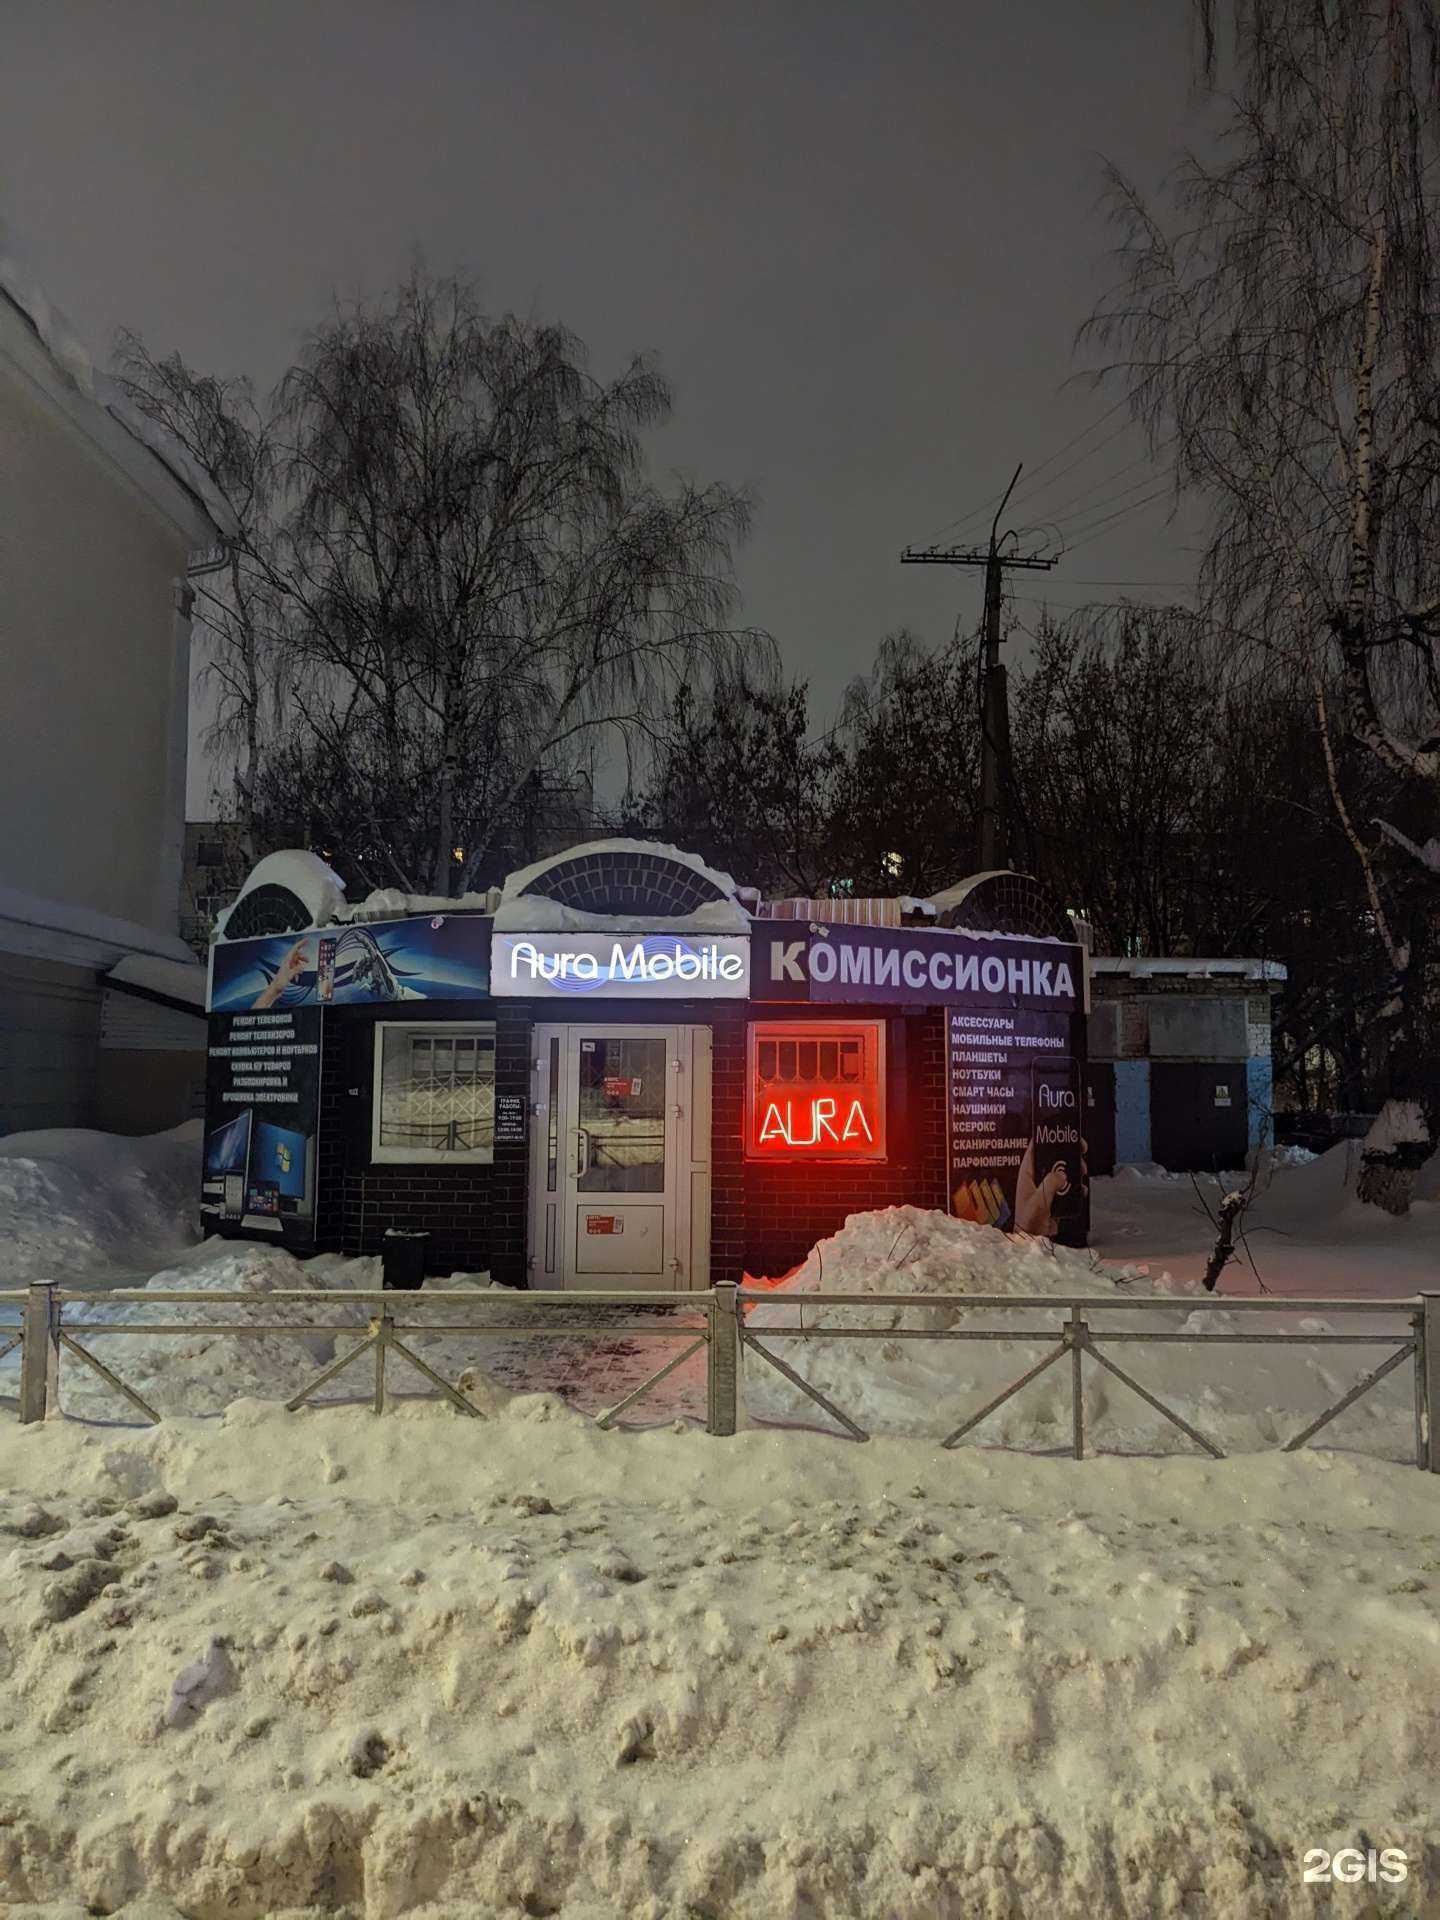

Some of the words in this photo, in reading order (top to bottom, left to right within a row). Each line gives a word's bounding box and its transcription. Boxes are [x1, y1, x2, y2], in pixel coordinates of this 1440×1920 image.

[510, 942, 598, 979] Aura
[608, 943, 744, 981] Mobile
[770, 941, 1076, 998] КОМИССИОНКА
[257, 1013, 293, 1025] ТЕЛЕФОНОВ
[952, 1016, 1014, 1029] АКСЕССУАРЫ
[952, 1033, 1013, 1046] МОБИЛЬНЫЕ
[1014, 1036, 1064, 1048] ТЕЛЕФОНЫ
[952, 1051, 1007, 1063] ПЛАНШЕТЫ
[952, 1069, 1001, 1080] НОУТБУКИ
[952, 1086, 985, 1097] СМАРТ
[987, 1086, 1014, 1097] ЧАСЫ
[1039, 1084, 1075, 1108] Aura
[952, 1104, 1006, 1115] НАУШНИКИ
[760, 1098, 873, 1145] AURA
[952, 1121, 996, 1132] КСЕРОКС
[1036, 1125, 1078, 1144] Mobile
[952, 1138, 1028, 1150] СКАНИРОВАНИЕ
[953, 1155, 1020, 1168] ПАРФЮМЕРИЯ
